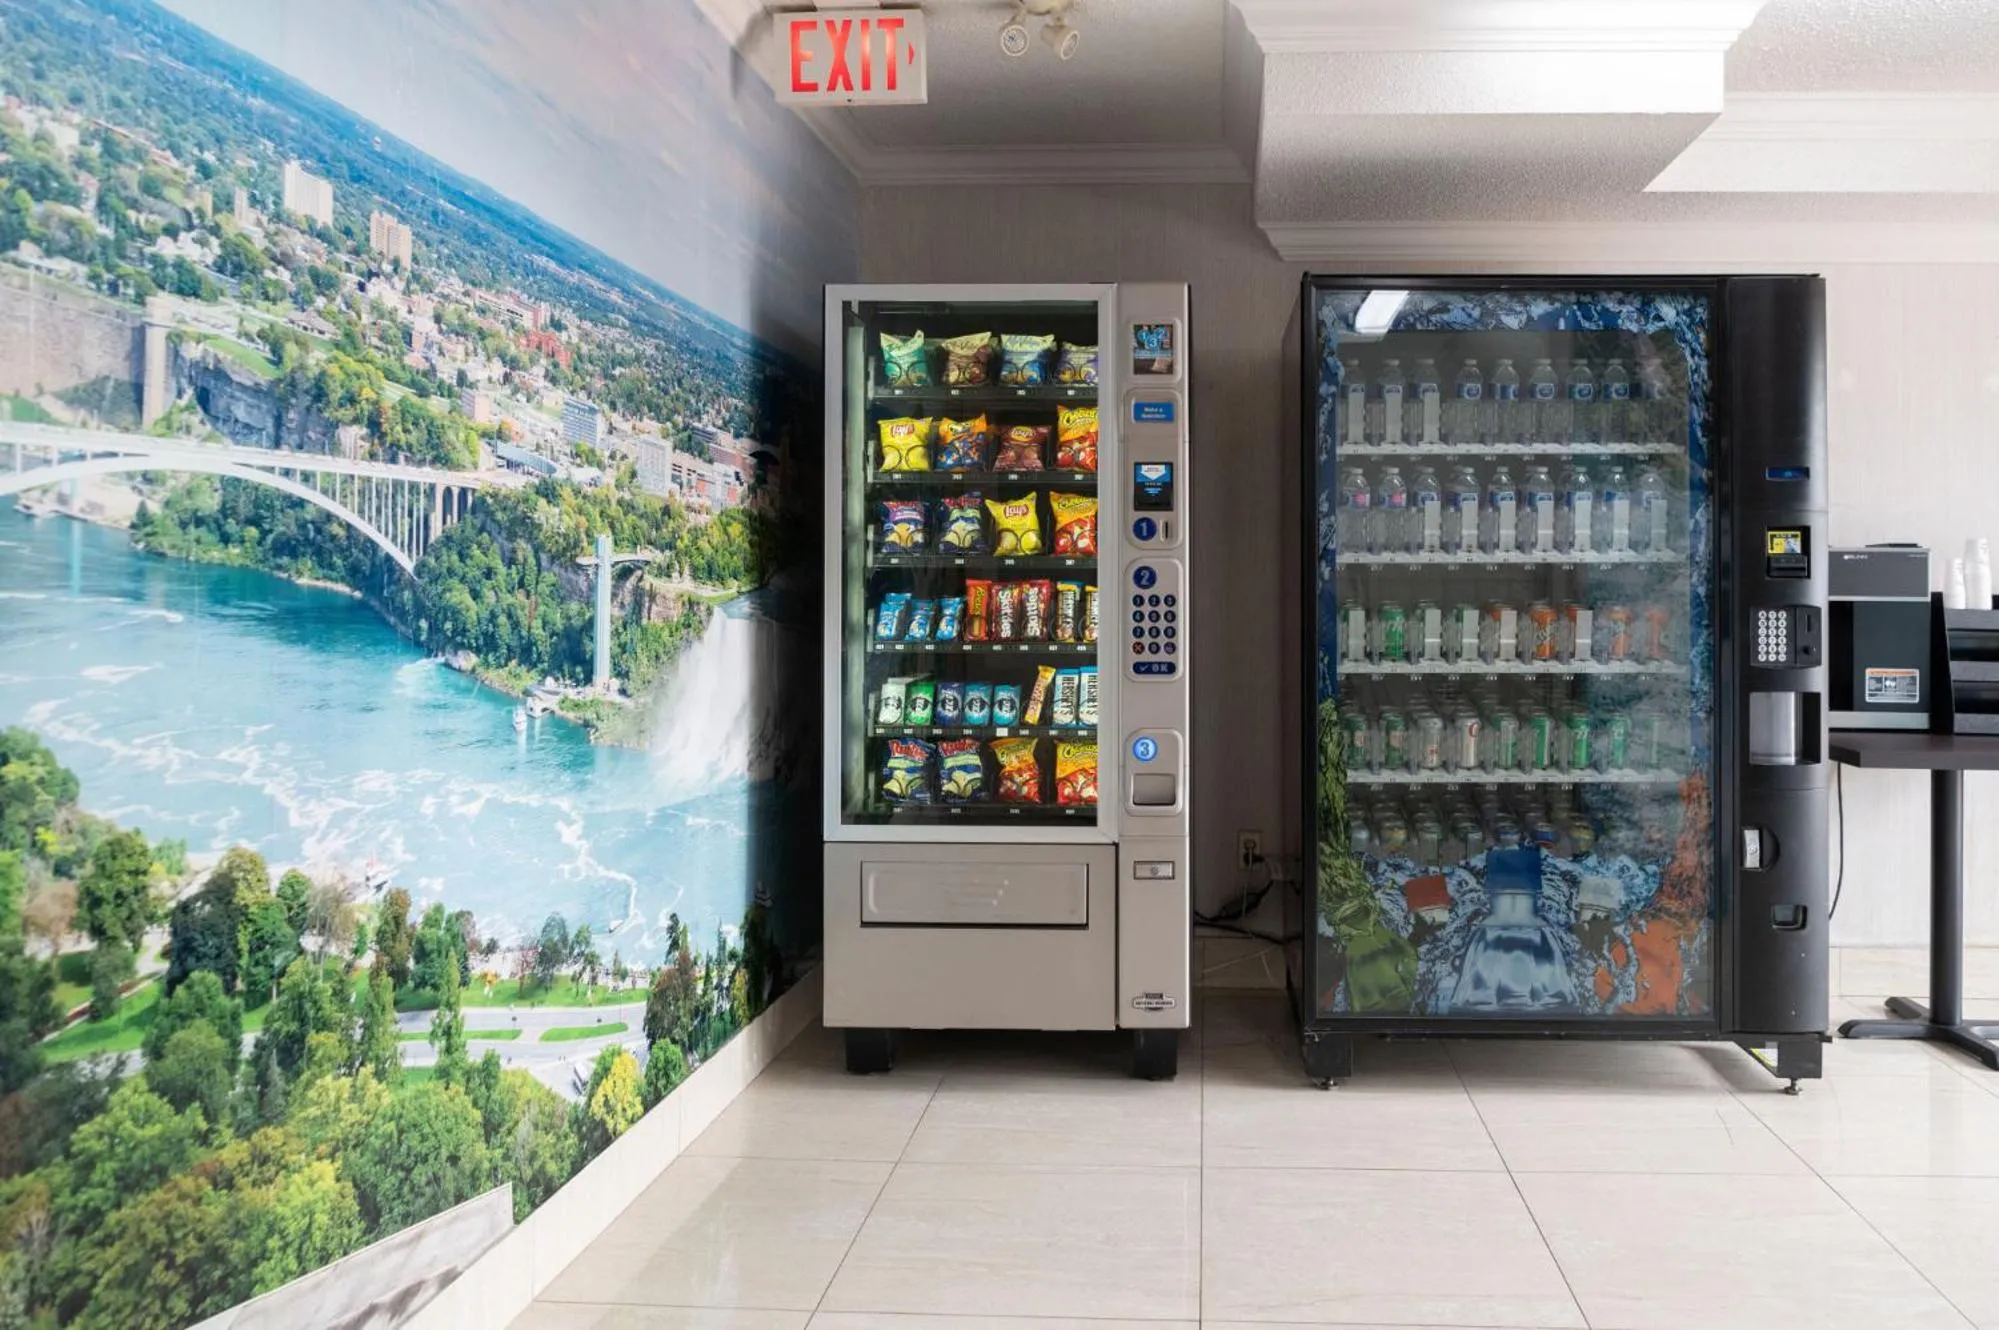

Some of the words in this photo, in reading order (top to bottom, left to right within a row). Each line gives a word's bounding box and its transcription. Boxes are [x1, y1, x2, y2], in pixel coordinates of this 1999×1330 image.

[790, 18, 904, 92] EXIT
[1005, 505, 1028, 517] Lay's
[1140, 522, 1148, 536] 1
[1141, 570, 1150, 585] 2
[999, 589, 1013, 638] Skittles
[1026, 587, 1040, 637] Skittles
[1152, 664, 1168, 672] OK
[1061, 676, 1074, 715] HERSHEY'S
[1140, 742, 1150, 757] 3
